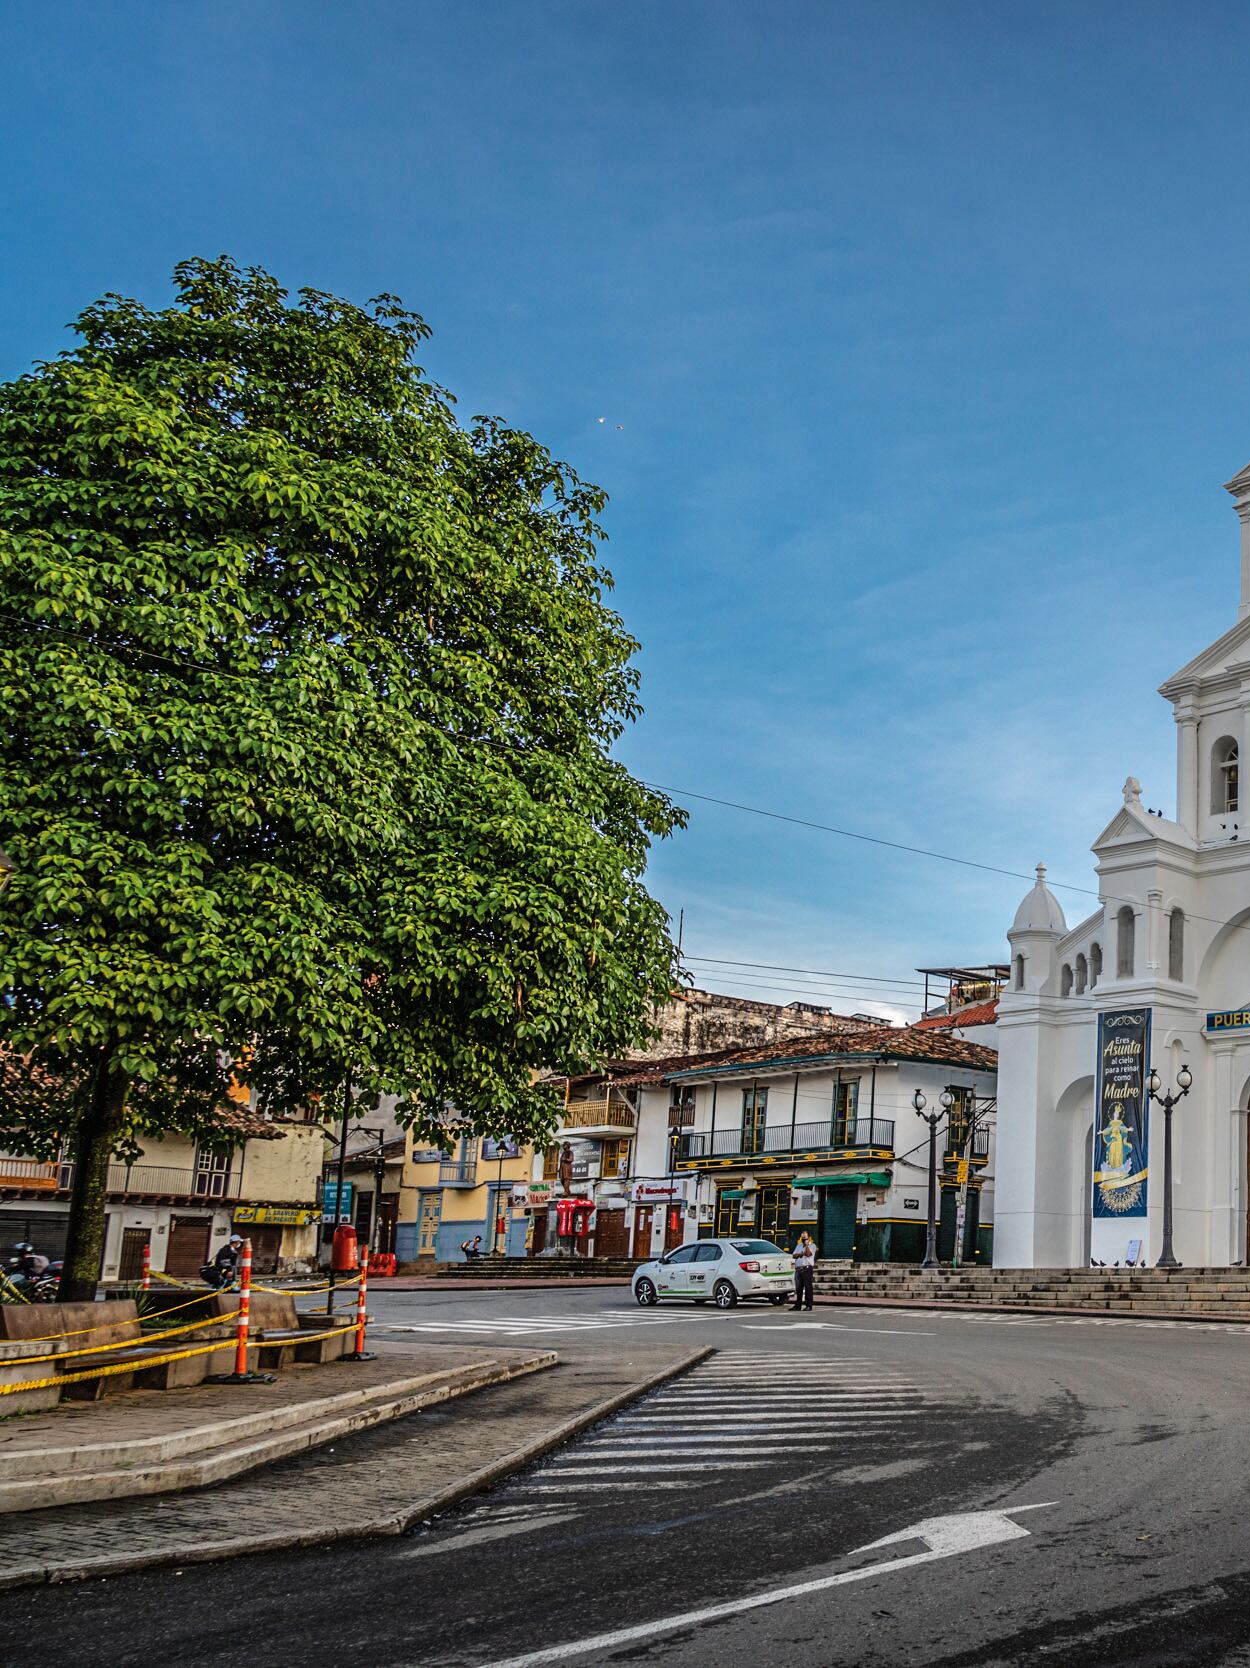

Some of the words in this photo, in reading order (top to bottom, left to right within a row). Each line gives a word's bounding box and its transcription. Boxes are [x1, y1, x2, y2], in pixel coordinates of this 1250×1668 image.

[1116, 1036, 1130, 1044] Eres
[1104, 1040, 1142, 1056] Asunta
[1118, 1056, 1134, 1064] cielo
[1105, 1067, 1120, 1075] para
[1120, 1064, 1139, 1072] reinar
[1104, 1082, 1140, 1100] Madre
